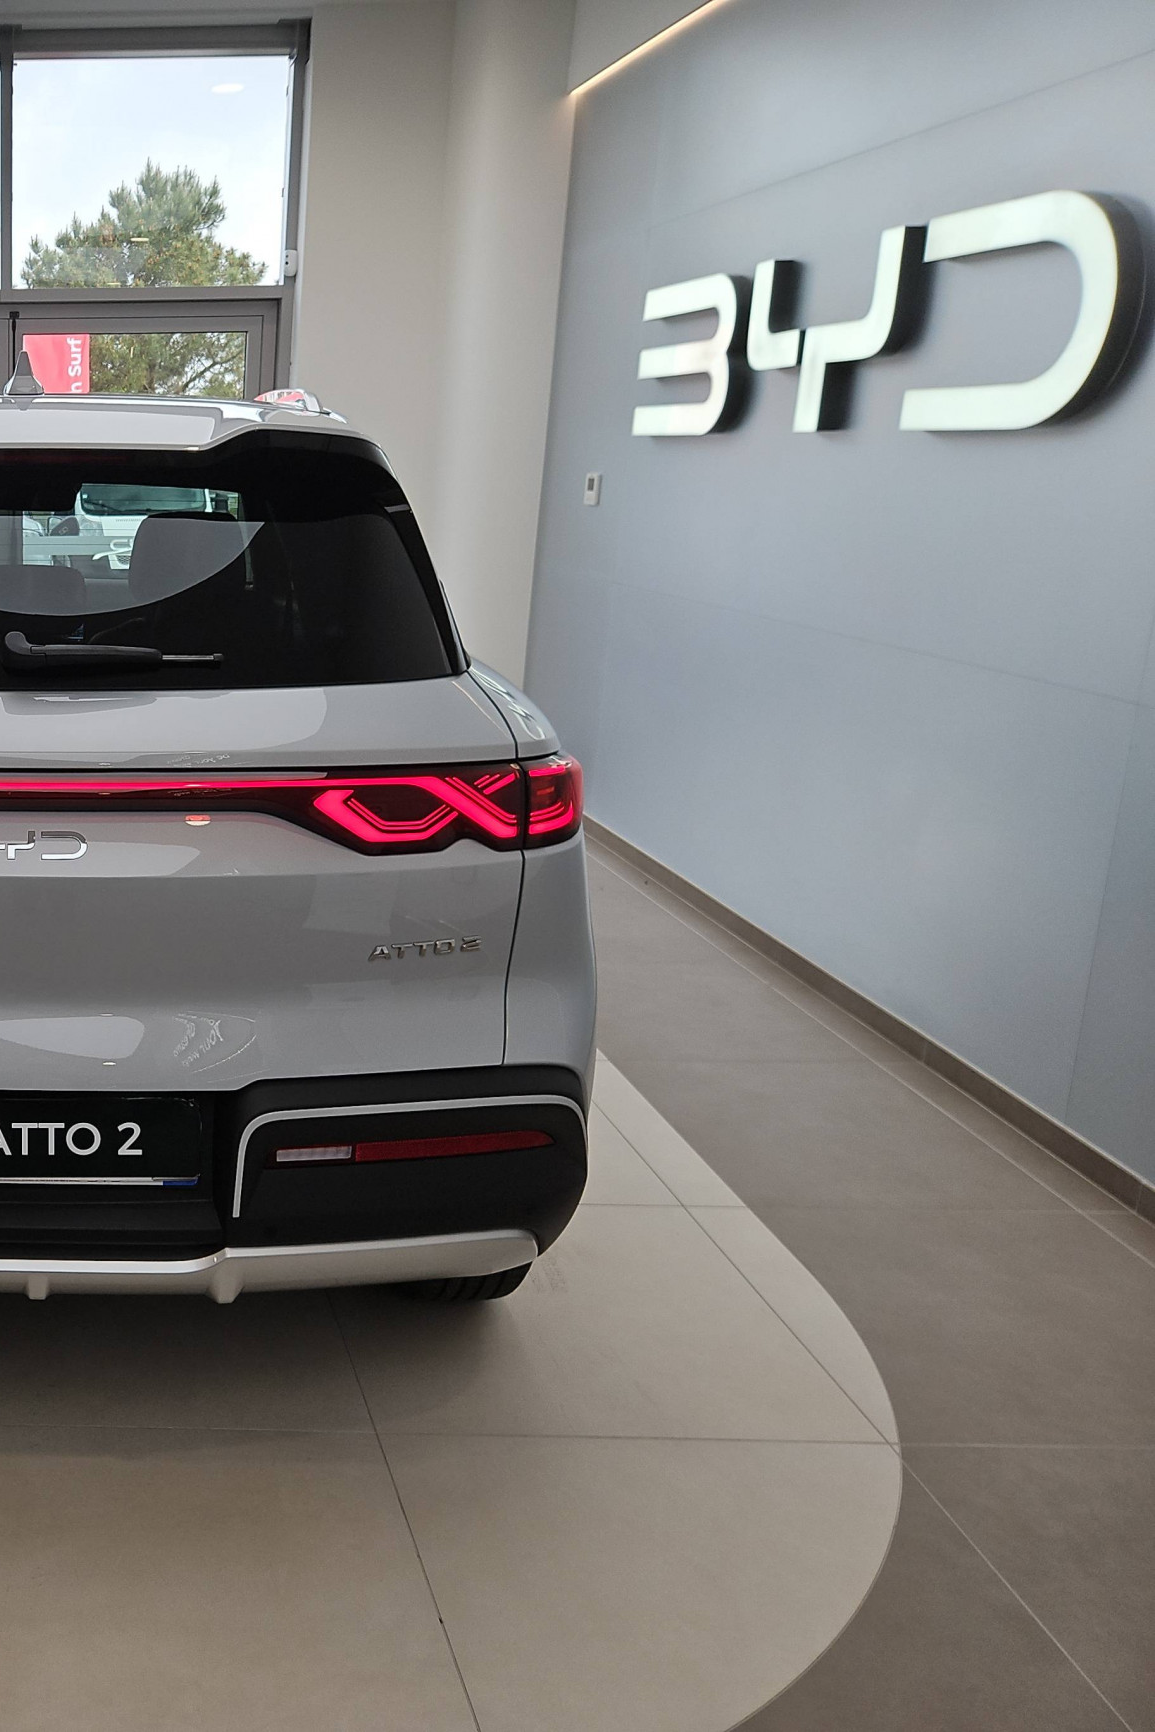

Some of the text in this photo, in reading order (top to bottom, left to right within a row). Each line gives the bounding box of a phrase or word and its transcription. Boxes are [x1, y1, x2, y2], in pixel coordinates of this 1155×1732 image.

[632, 189, 1126, 436] BYD
[67, 337, 82, 377] Surf
[368, 935, 482, 961] ATTO 2
[116, 1121, 143, 1156] 2
